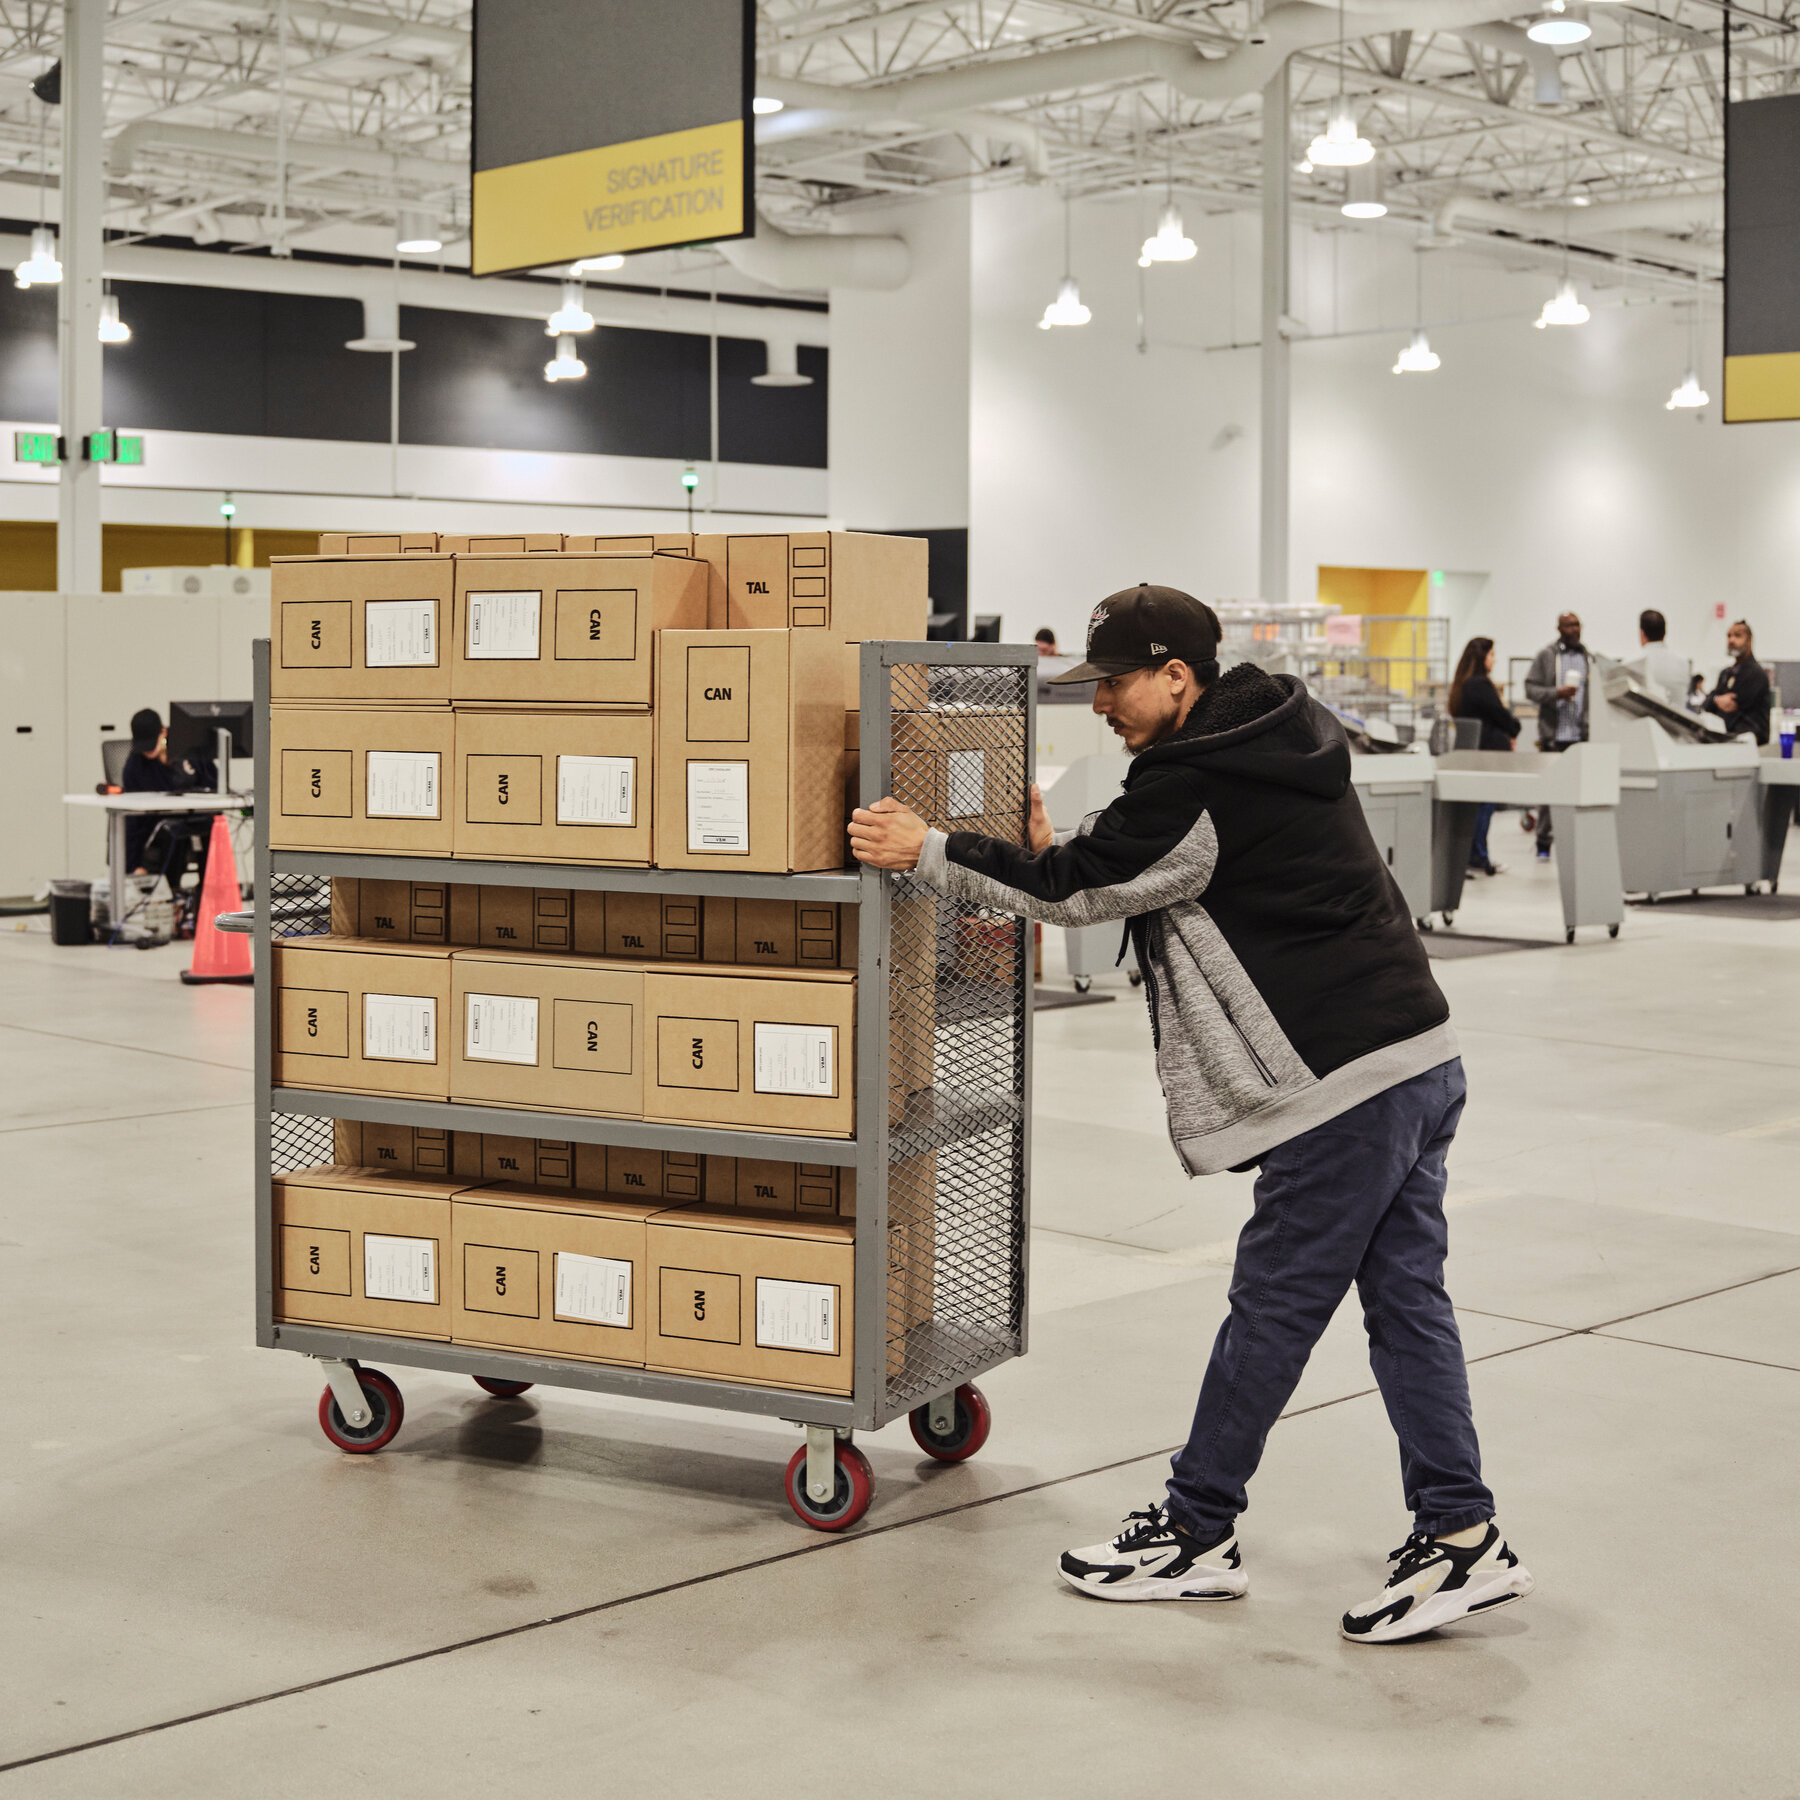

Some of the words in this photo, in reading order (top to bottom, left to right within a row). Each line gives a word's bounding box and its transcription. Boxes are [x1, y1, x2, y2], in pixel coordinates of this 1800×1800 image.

[606, 149, 724, 194] SIGNATURE
[583, 187, 724, 232] VERIFICATION
[745, 581, 770, 595] TAL
[311, 620, 321, 650] CAN
[589, 609, 601, 641] CAN
[704, 687, 732, 701] CAN
[311, 768, 322, 799] CAN
[498, 774, 509, 805] CAN
[374, 916, 395, 930] TAL
[495, 926, 518, 940] TAL
[621, 935, 645, 948] TAL
[753, 941, 778, 954] TAL
[307, 1007, 318, 1038] CAN
[587, 1020, 598, 1052] CAN
[692, 1038, 704, 1070] CAN
[377, 1147, 398, 1160] TAL
[497, 1157, 520, 1171] TAL
[623, 1172, 646, 1187] TAL
[753, 1184, 778, 1199] TAL
[309, 1245, 320, 1275] CAN
[495, 1266, 507, 1297] CAN
[694, 1290, 706, 1322] CAN
